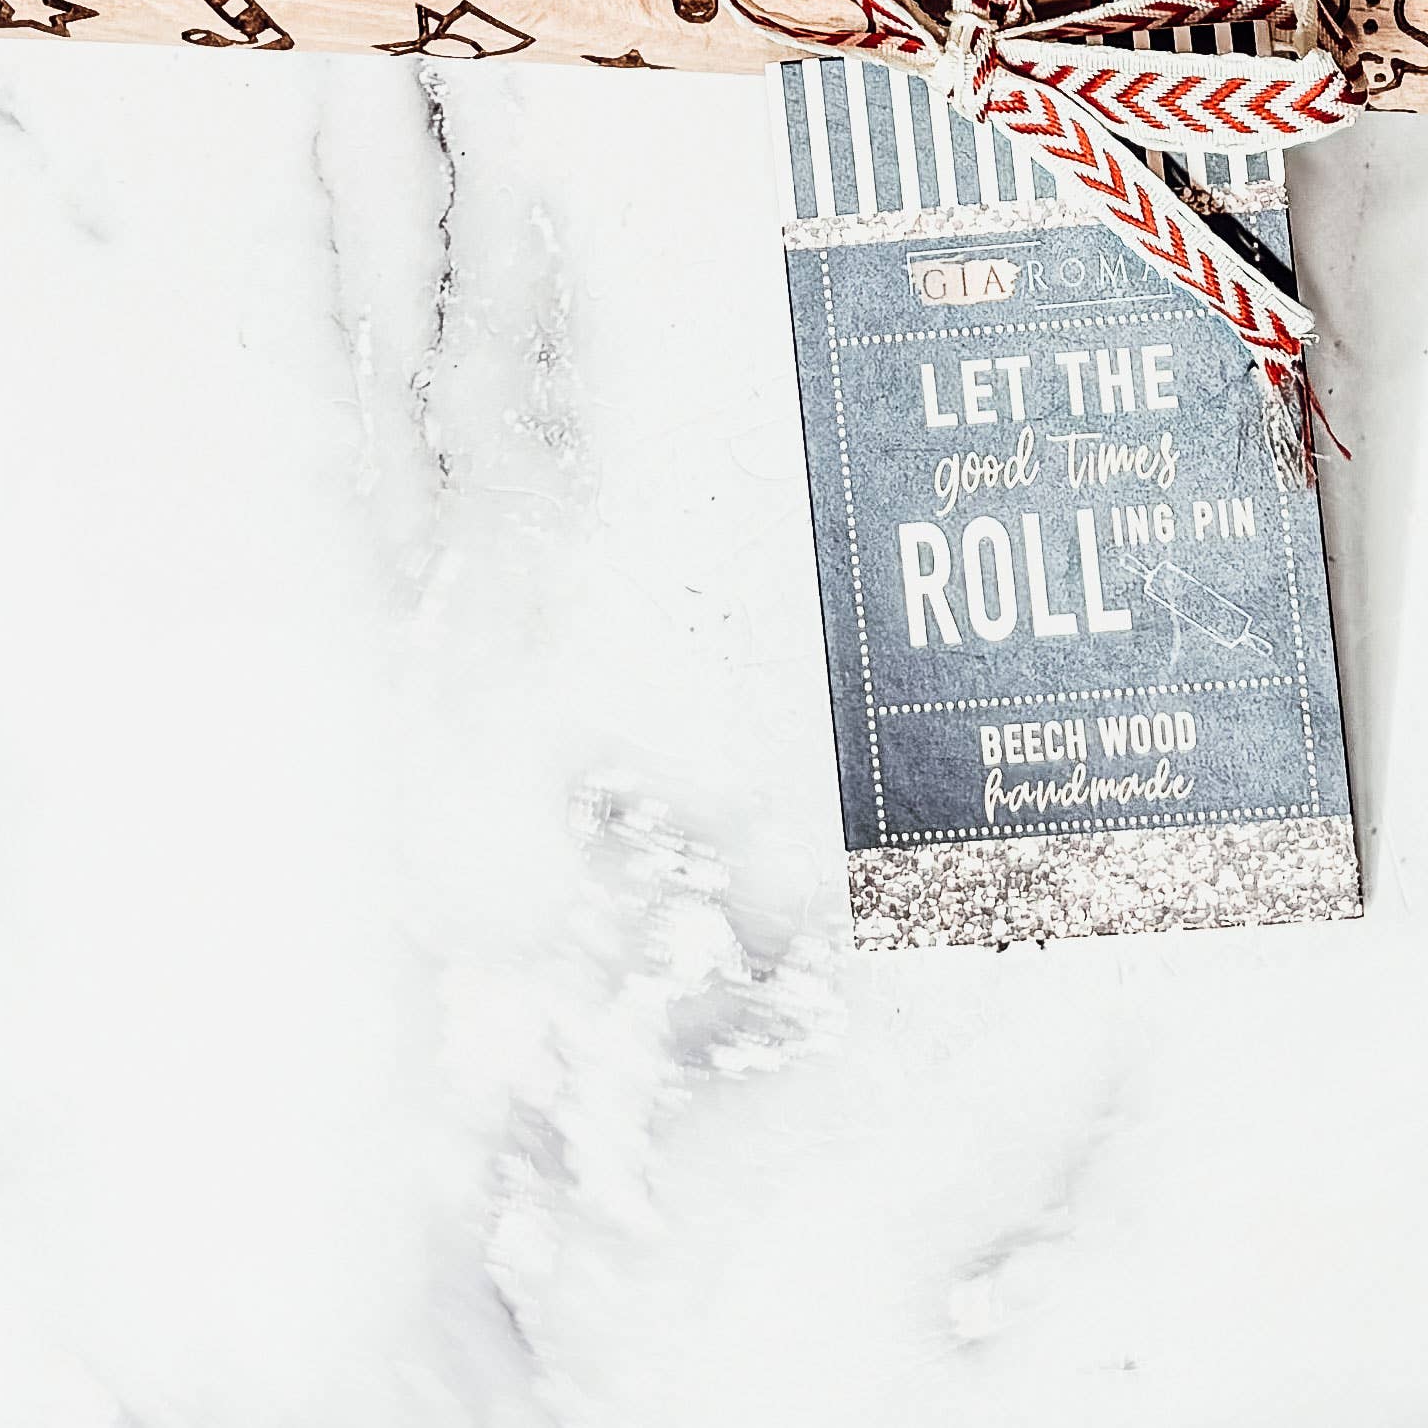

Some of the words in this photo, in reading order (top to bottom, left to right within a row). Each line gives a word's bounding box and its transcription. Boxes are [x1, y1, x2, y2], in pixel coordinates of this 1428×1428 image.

[923, 265, 1006, 301] GIA
[921, 355, 1031, 428] LET
[1054, 343, 1179, 417] THE
[933, 424, 1040, 517] good
[1191, 496, 1257, 541] PIN
[980, 718, 1088, 766] BEECH
[1096, 710, 1197, 757] WOOD
[983, 757, 1196, 825] handmade
